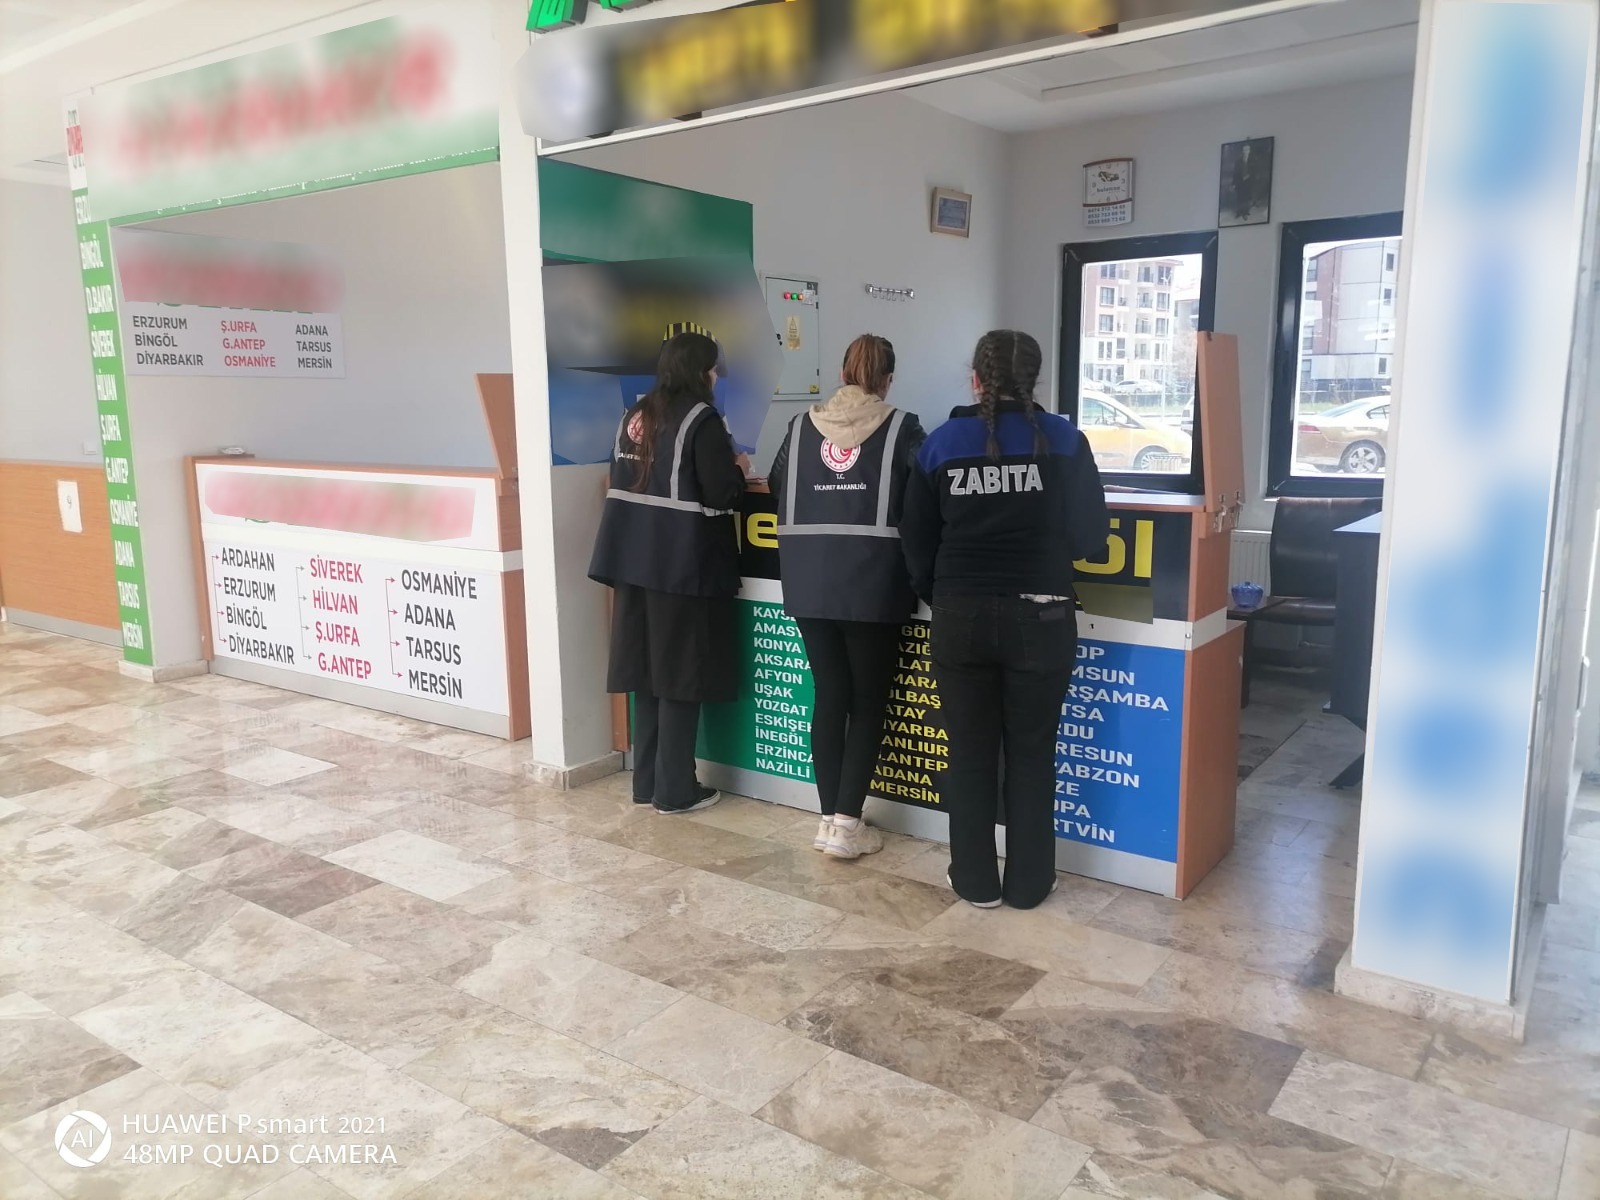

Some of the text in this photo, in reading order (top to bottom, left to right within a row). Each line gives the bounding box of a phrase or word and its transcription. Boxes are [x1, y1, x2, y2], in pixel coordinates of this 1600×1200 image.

[85, 284, 114, 314] D.BAKIR
[132, 315, 188, 330] ERZURUM
[220, 320, 257, 334] Ş.URFA
[295, 324, 328, 336] ADANA
[134, 333, 178, 348] BİNGÖL
[222, 338, 266, 350] G.ANTEP
[296, 341, 332, 352] TARSUS
[136, 352, 204, 367] DİYARBAKIR
[224, 354, 276, 368] OSMANİYE
[298, 356, 332, 369] MERSİN
[100, 415, 122, 445] Ş.URFA
[105, 457, 129, 484] G.ANTEP
[947, 464, 1043, 495] ZABITA
[836, 482, 866, 490] BAKANLIĞI
[114, 540, 136, 568] ADANA
[222, 547, 275, 572] ARDAHAN
[310, 554, 364, 584] SİVEREK
[118, 580, 140, 609] TARSUS
[224, 576, 276, 602] ERZURUM
[401, 569, 478, 600] OSMANİYE
[312, 586, 358, 615] HİLVAN
[226, 602, 268, 630] BİNGÖL
[404, 603, 456, 631] ADANA
[753, 606, 796, 622] KAYS
[315, 620, 360, 647] Ş.URFA
[754, 637, 802, 654] KONYA
[228, 632, 295, 665] DİYARBAKIR
[405, 636, 462, 666] TARSUS
[318, 652, 372, 680] G.ANTEP
[754, 668, 803, 684] AFYON
[408, 669, 462, 699] MERSİN
[754, 682, 794, 698] UŞAK
[754, 698, 808, 716] YOZGAT
[755, 726, 808, 747] İNEGÖL
[1055, 741, 1133, 767] RESUN
[756, 758, 810, 778] NAZİLLİ
[874, 764, 933, 786] ADANA
[1054, 762, 1140, 788] ABZON
[870, 778, 940, 804] MERSİN
